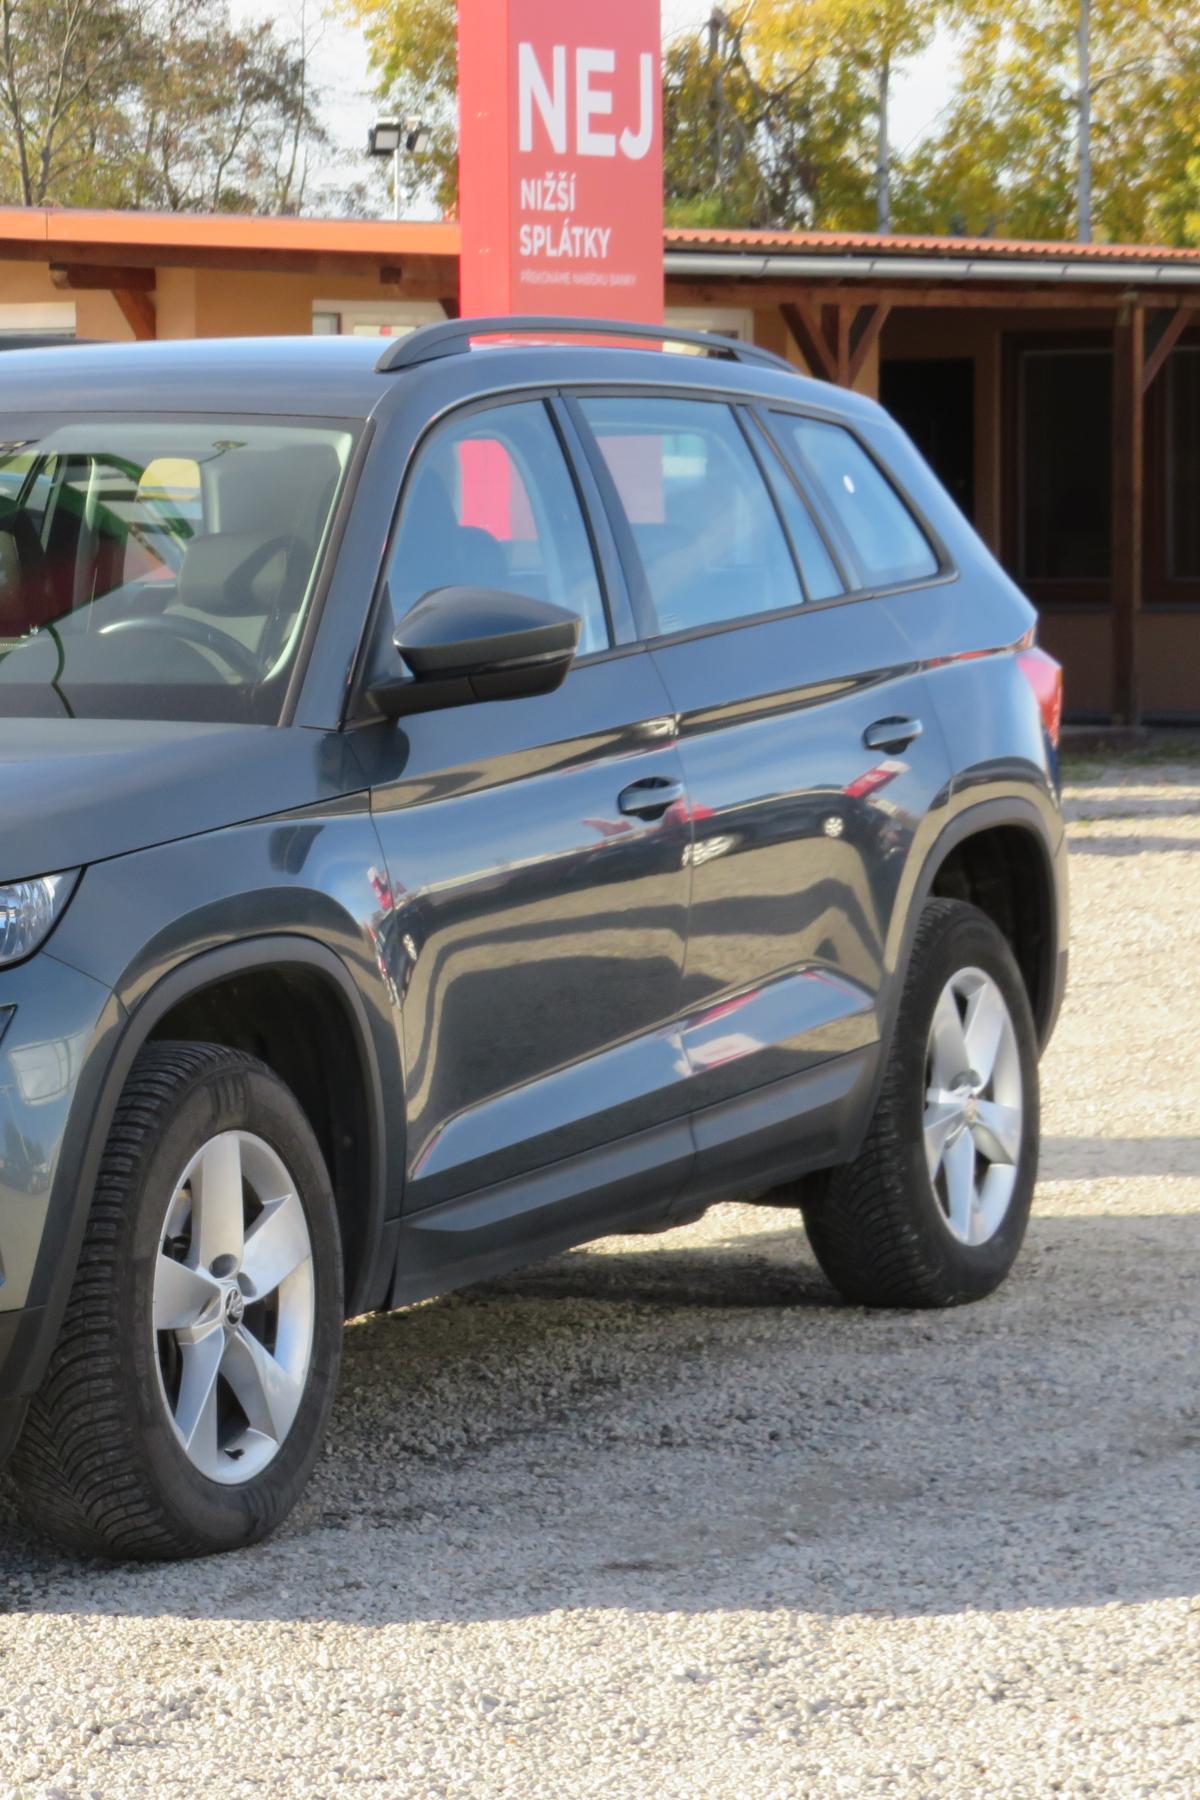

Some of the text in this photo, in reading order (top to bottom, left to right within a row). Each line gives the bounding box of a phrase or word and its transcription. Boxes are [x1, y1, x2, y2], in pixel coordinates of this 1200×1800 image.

[518, 42, 654, 161] NEJ
[520, 171, 576, 212] NIŽŠÍ
[519, 218, 611, 259] SPLÁTKY
